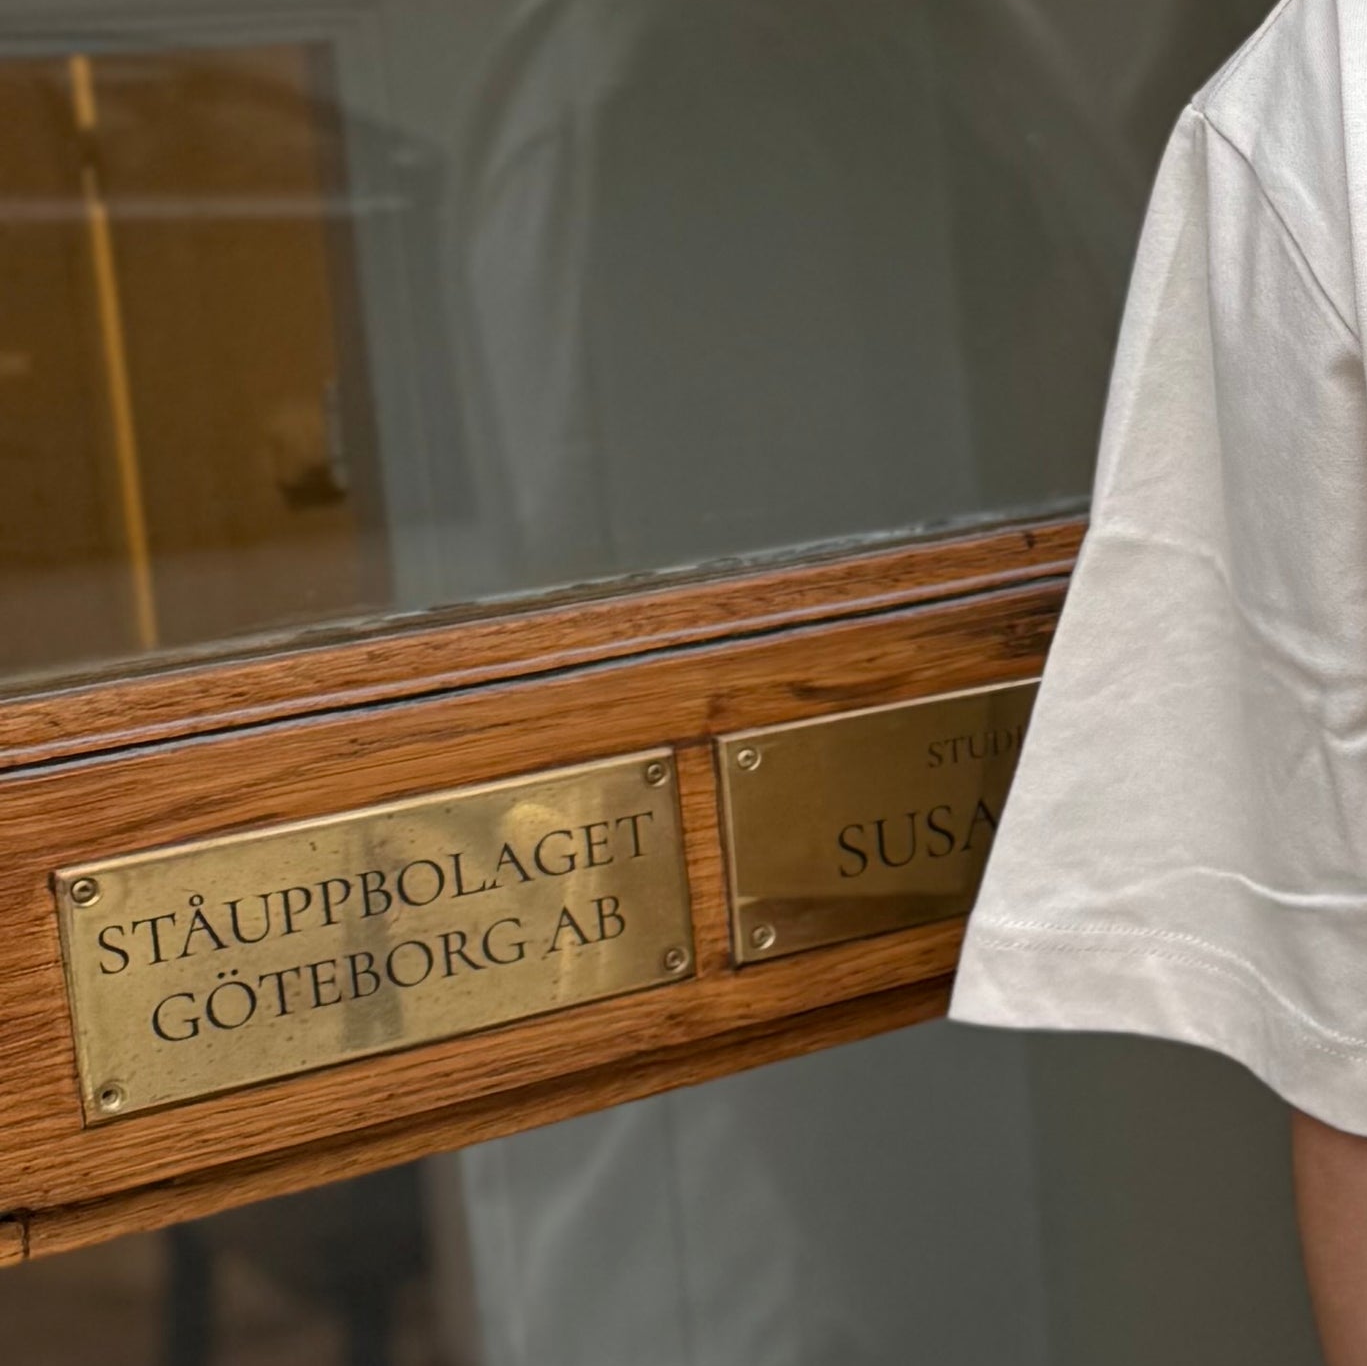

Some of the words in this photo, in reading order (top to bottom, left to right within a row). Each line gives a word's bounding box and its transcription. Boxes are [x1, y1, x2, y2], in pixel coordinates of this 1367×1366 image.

[97, 810, 654, 976] STÅUPPBOLAGET
[150, 917, 527, 1043] GÖTEBORG
[546, 894, 628, 953] AB
